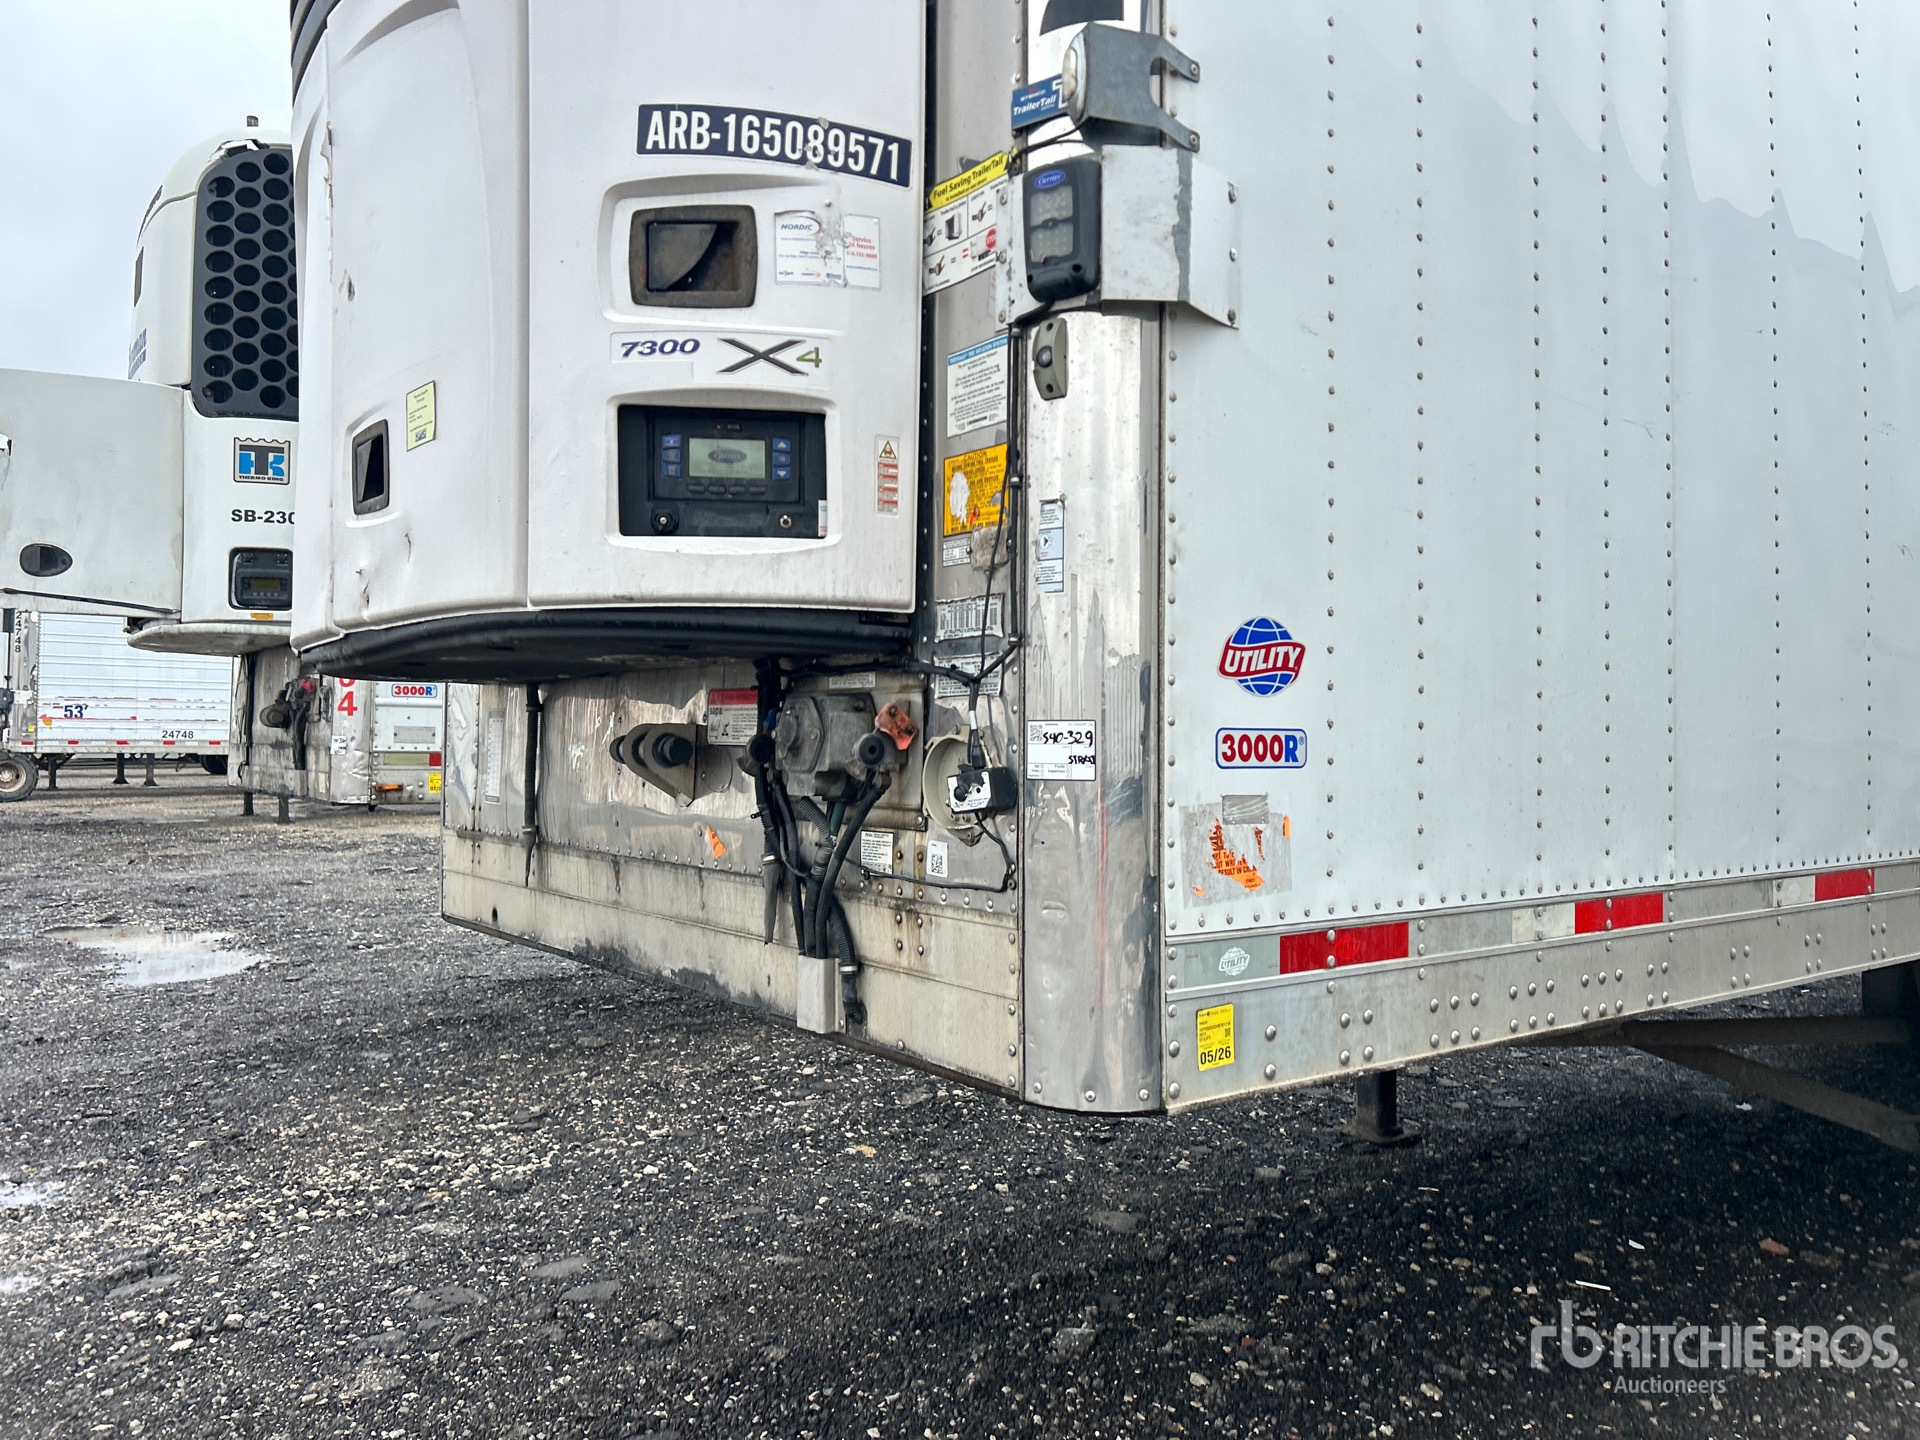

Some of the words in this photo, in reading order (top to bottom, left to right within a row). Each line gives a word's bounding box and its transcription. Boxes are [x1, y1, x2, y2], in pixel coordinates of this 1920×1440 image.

[1013, 94, 1056, 116] TrailerTail
[645, 110, 900, 181] ARB-165089571
[934, 186, 948, 199] Fuel
[949, 174, 972, 192] Saving
[972, 154, 1004, 180] TrailerTail
[1038, 172, 1064, 187] Carrier
[620, 338, 700, 358] 7300
[964, 451, 987, 461] CAUTION
[1224, 646, 1301, 673] UTILITY
[162, 730, 194, 739] 24748
[1221, 956, 1248, 969] UTILITY
[1200, 1046, 1231, 1064] 05/26
